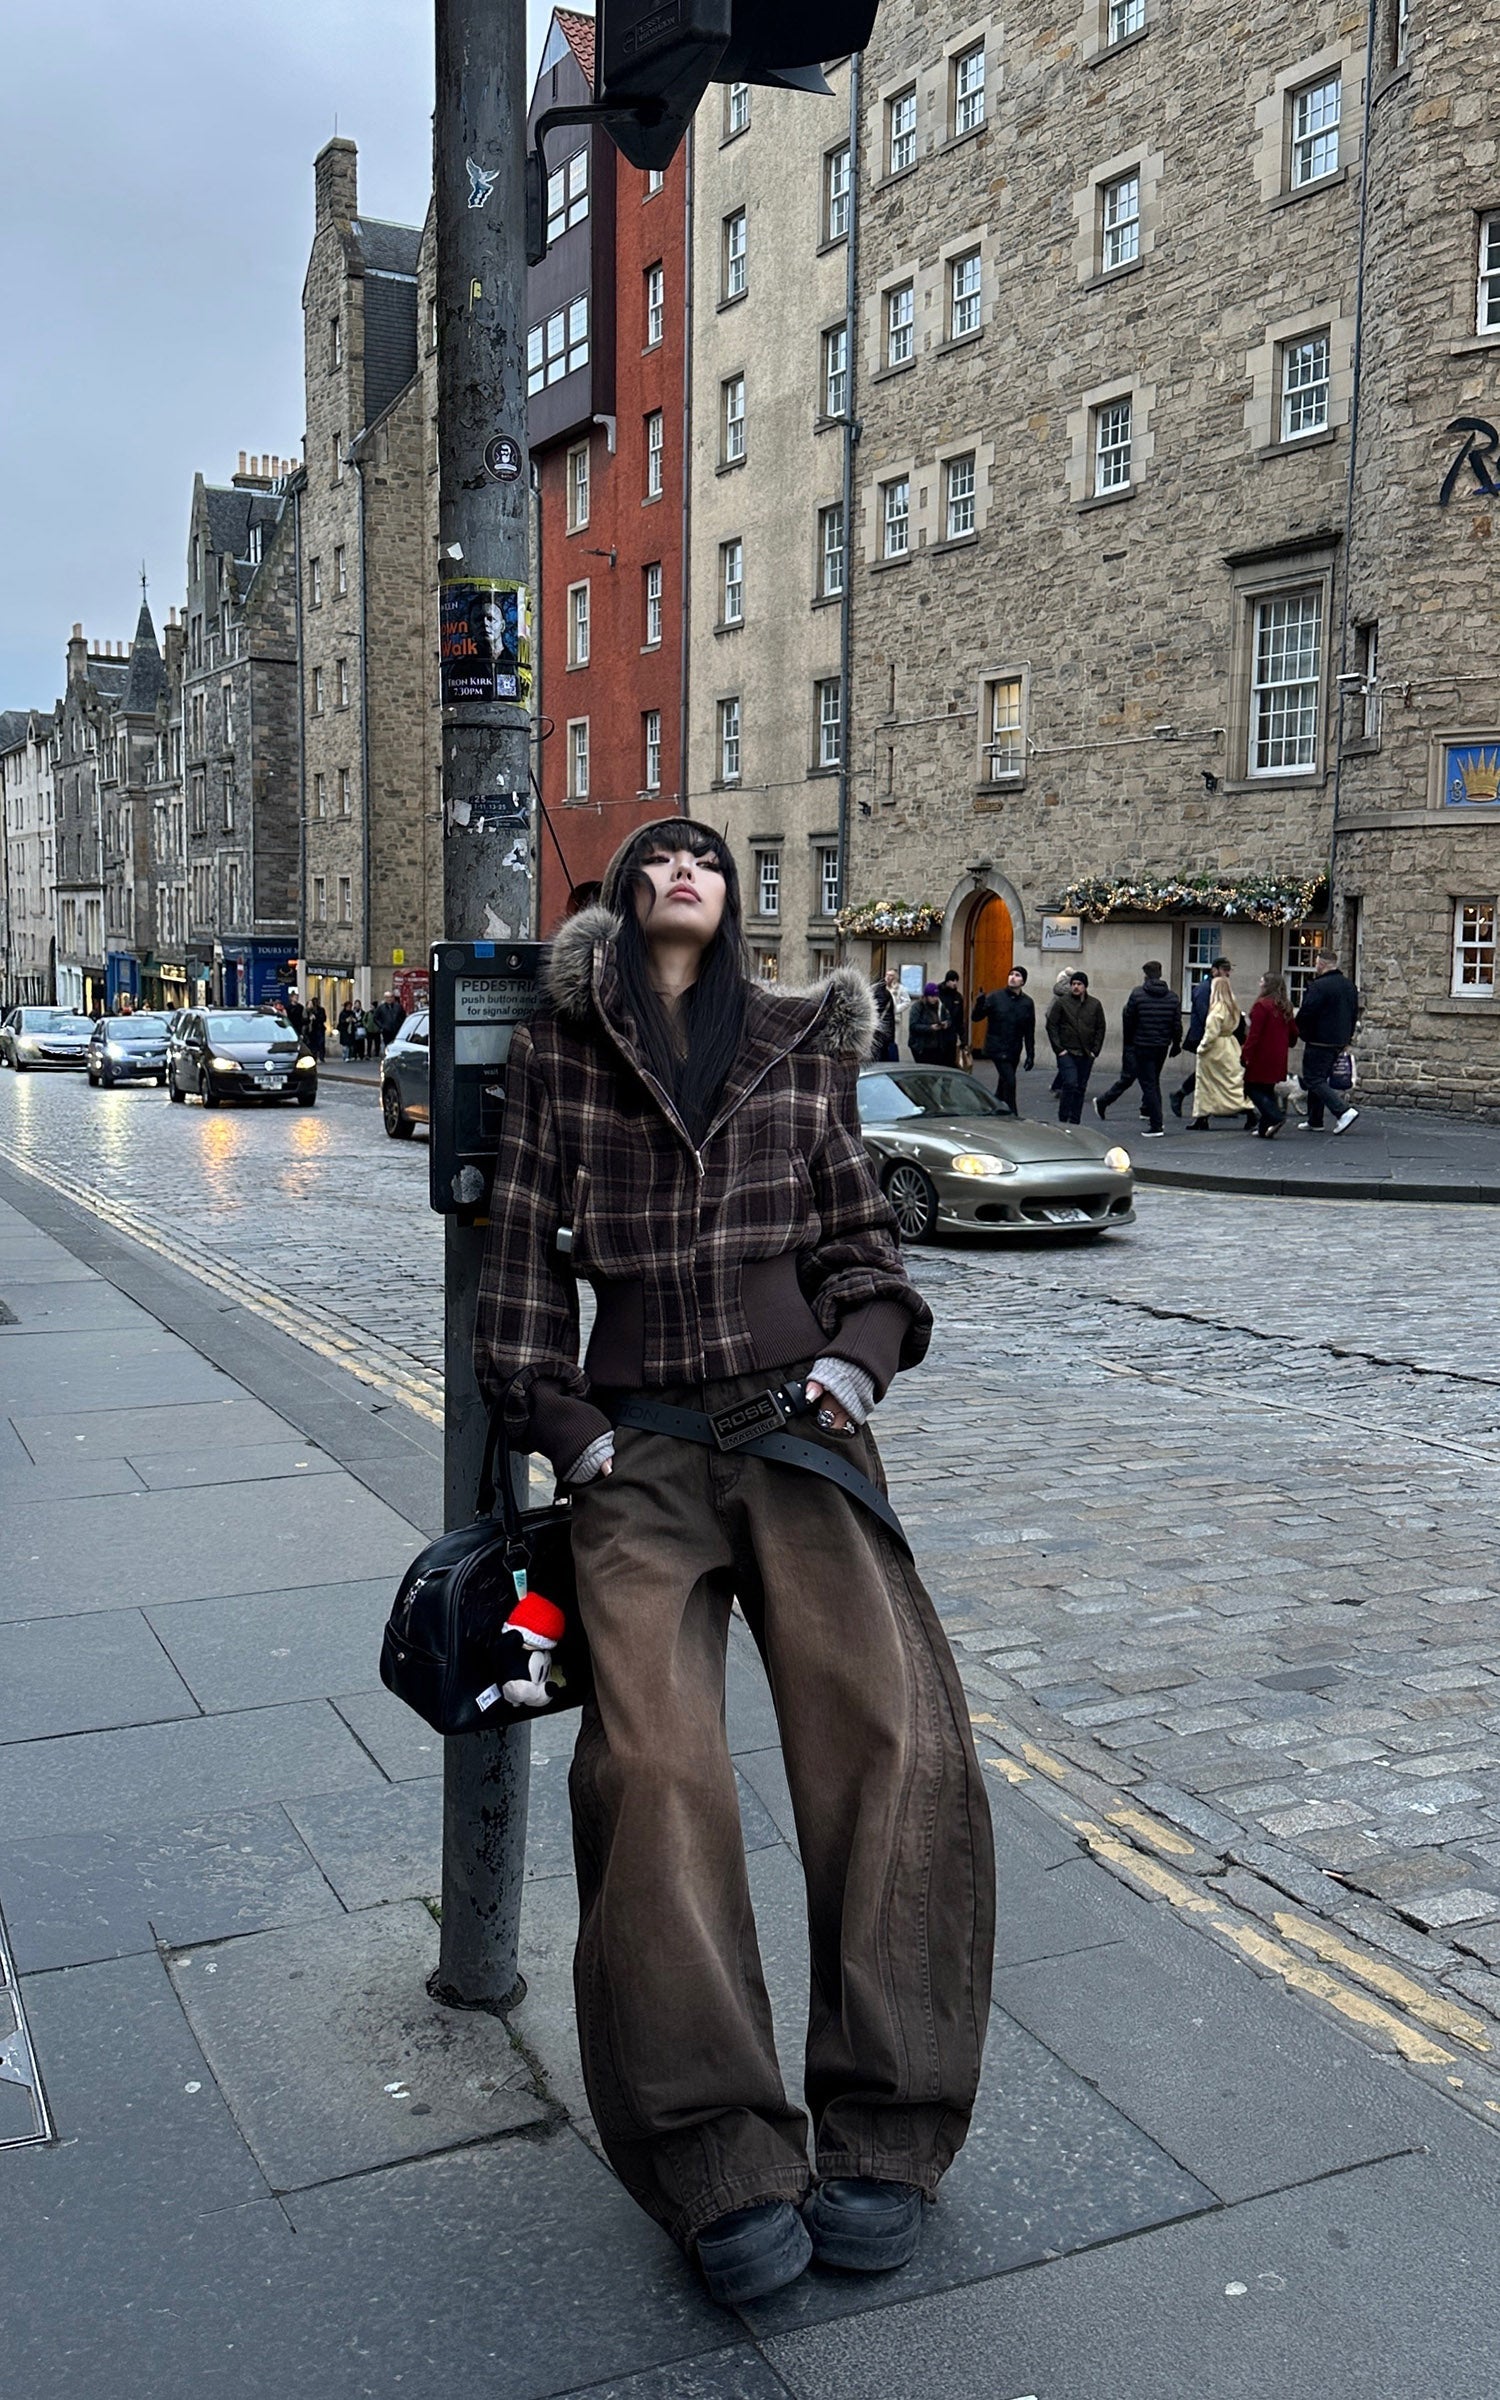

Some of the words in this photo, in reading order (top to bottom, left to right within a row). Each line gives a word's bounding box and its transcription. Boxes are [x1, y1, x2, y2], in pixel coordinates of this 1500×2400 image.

[469, 676, 493, 686] KIRK
[257, 946, 282, 954] TOURS
[461, 995, 486, 1006] push
[487, 994, 518, 1004] button
[519, 995, 538, 1004] and
[467, 1006, 481, 1015] for
[482, 1005, 511, 1017] signal
